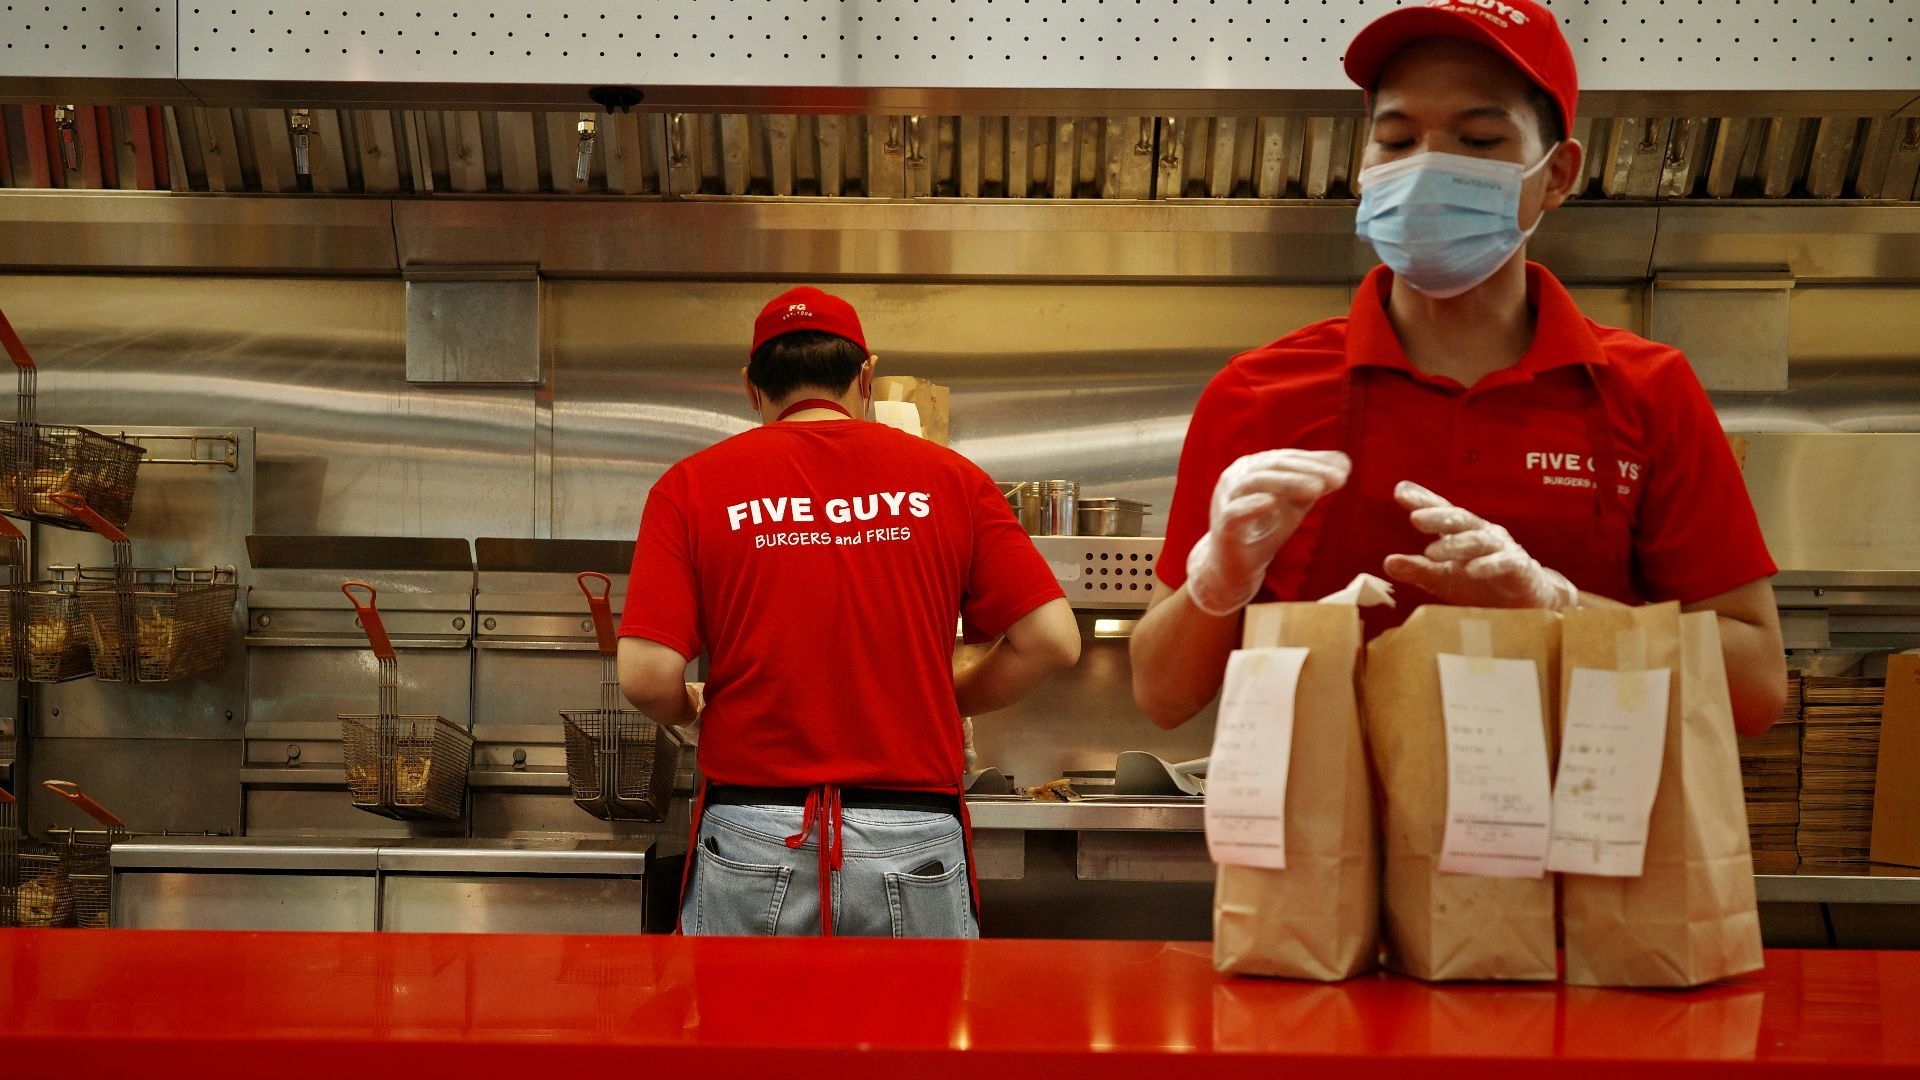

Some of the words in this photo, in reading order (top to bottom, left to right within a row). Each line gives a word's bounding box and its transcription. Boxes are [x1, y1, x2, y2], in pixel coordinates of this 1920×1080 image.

[789, 303, 806, 312] FG
[1526, 452, 1581, 470] FIVE
[727, 497, 814, 531] FIVE
[825, 491, 930, 524] GUYS
[755, 532, 831, 548] BURGERS
[835, 532, 862, 545] and
[866, 526, 911, 543] FRIES
